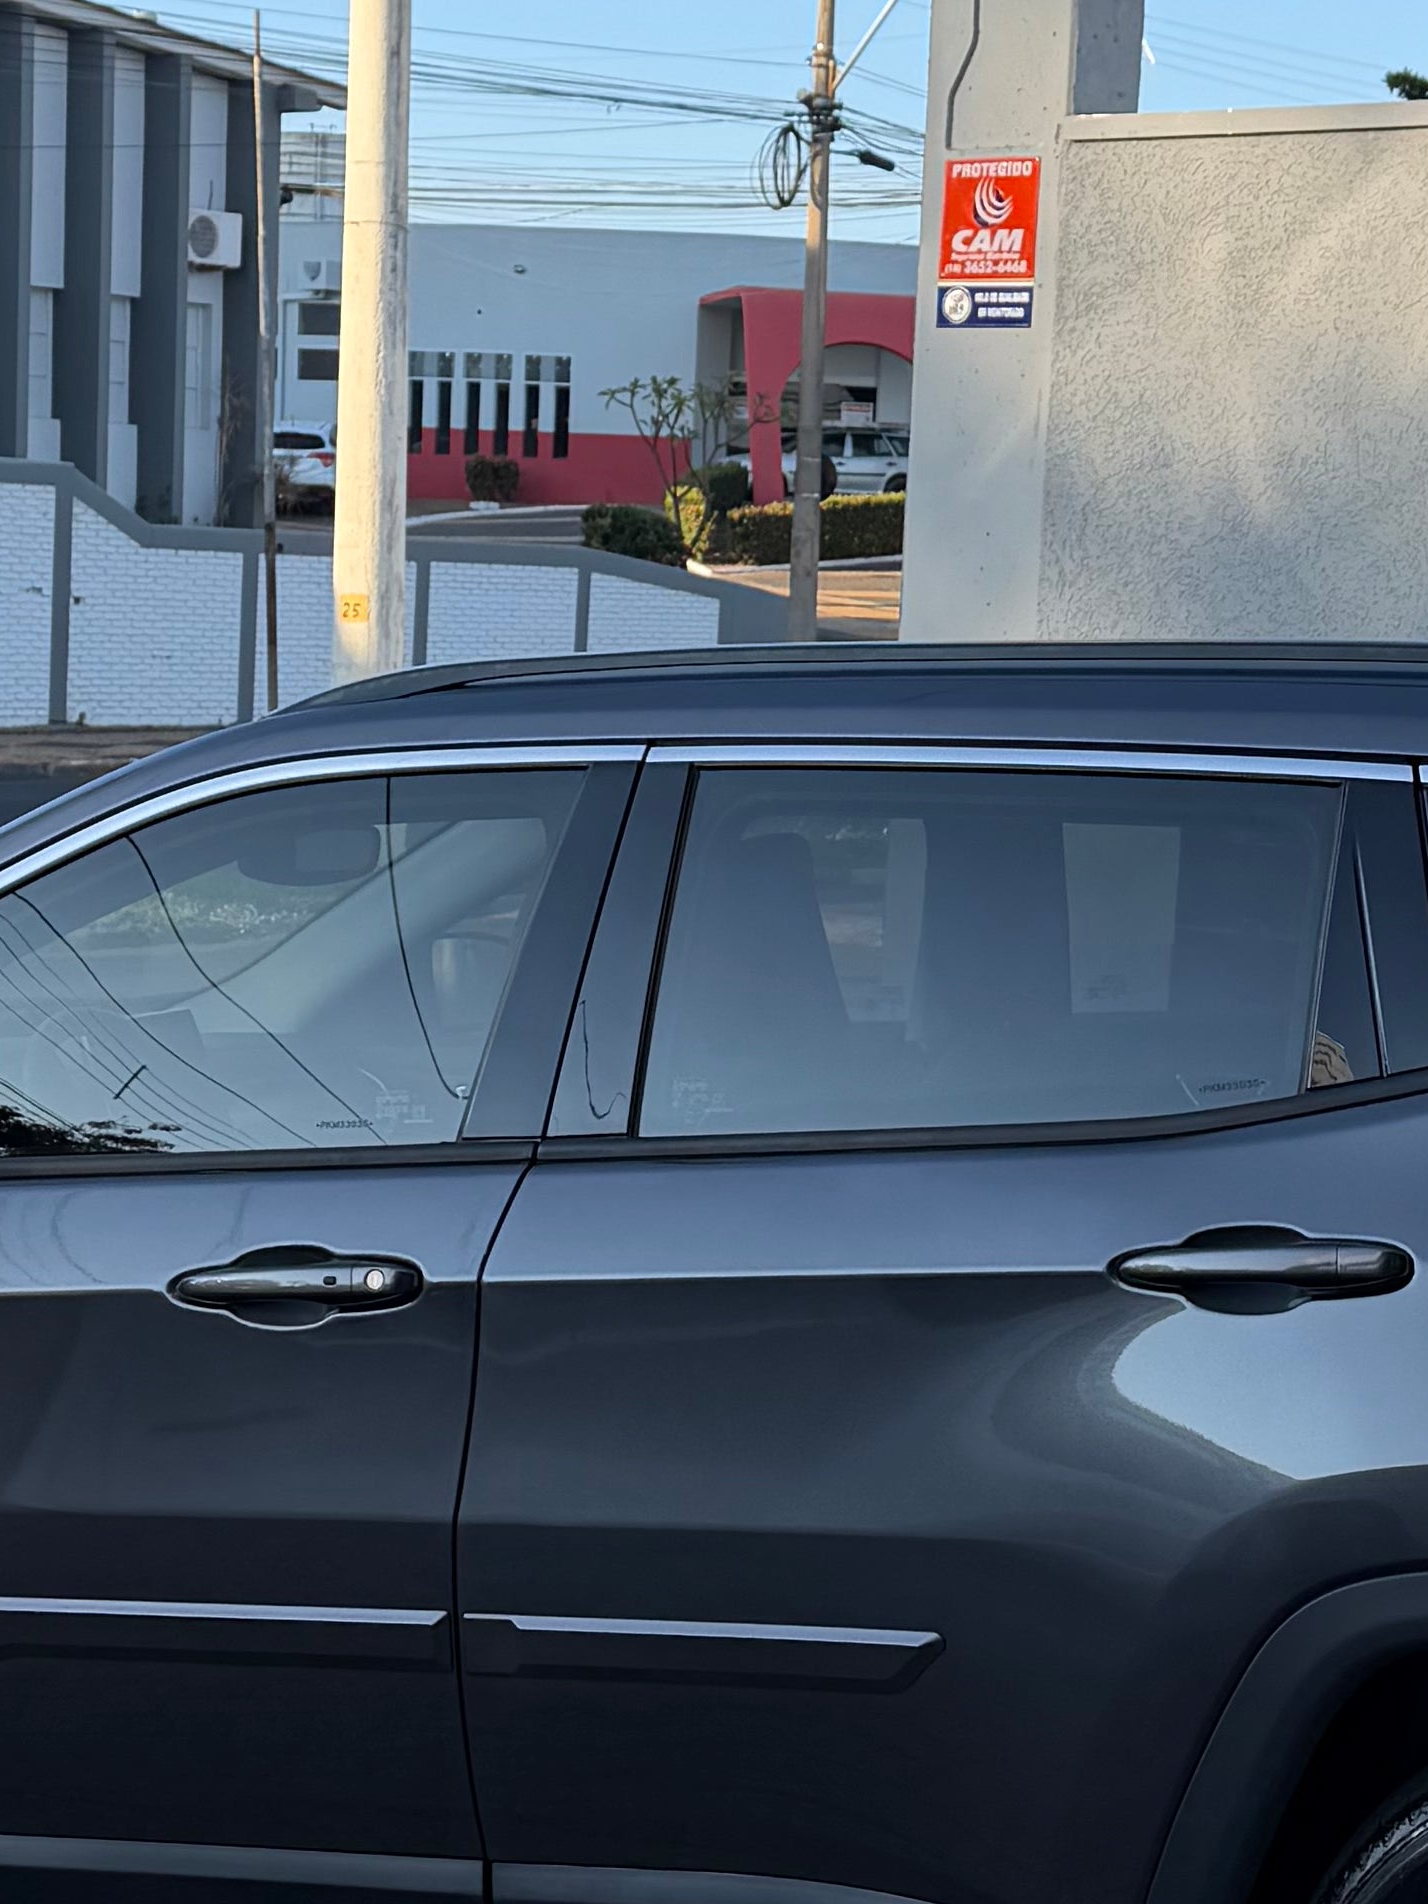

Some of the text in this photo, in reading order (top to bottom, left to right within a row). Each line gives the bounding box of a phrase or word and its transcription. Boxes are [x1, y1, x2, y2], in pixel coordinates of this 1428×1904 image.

[952, 161, 1033, 178] PROTEGIDO
[951, 229, 1024, 252] CAM
[342, 602, 361, 618] 25
